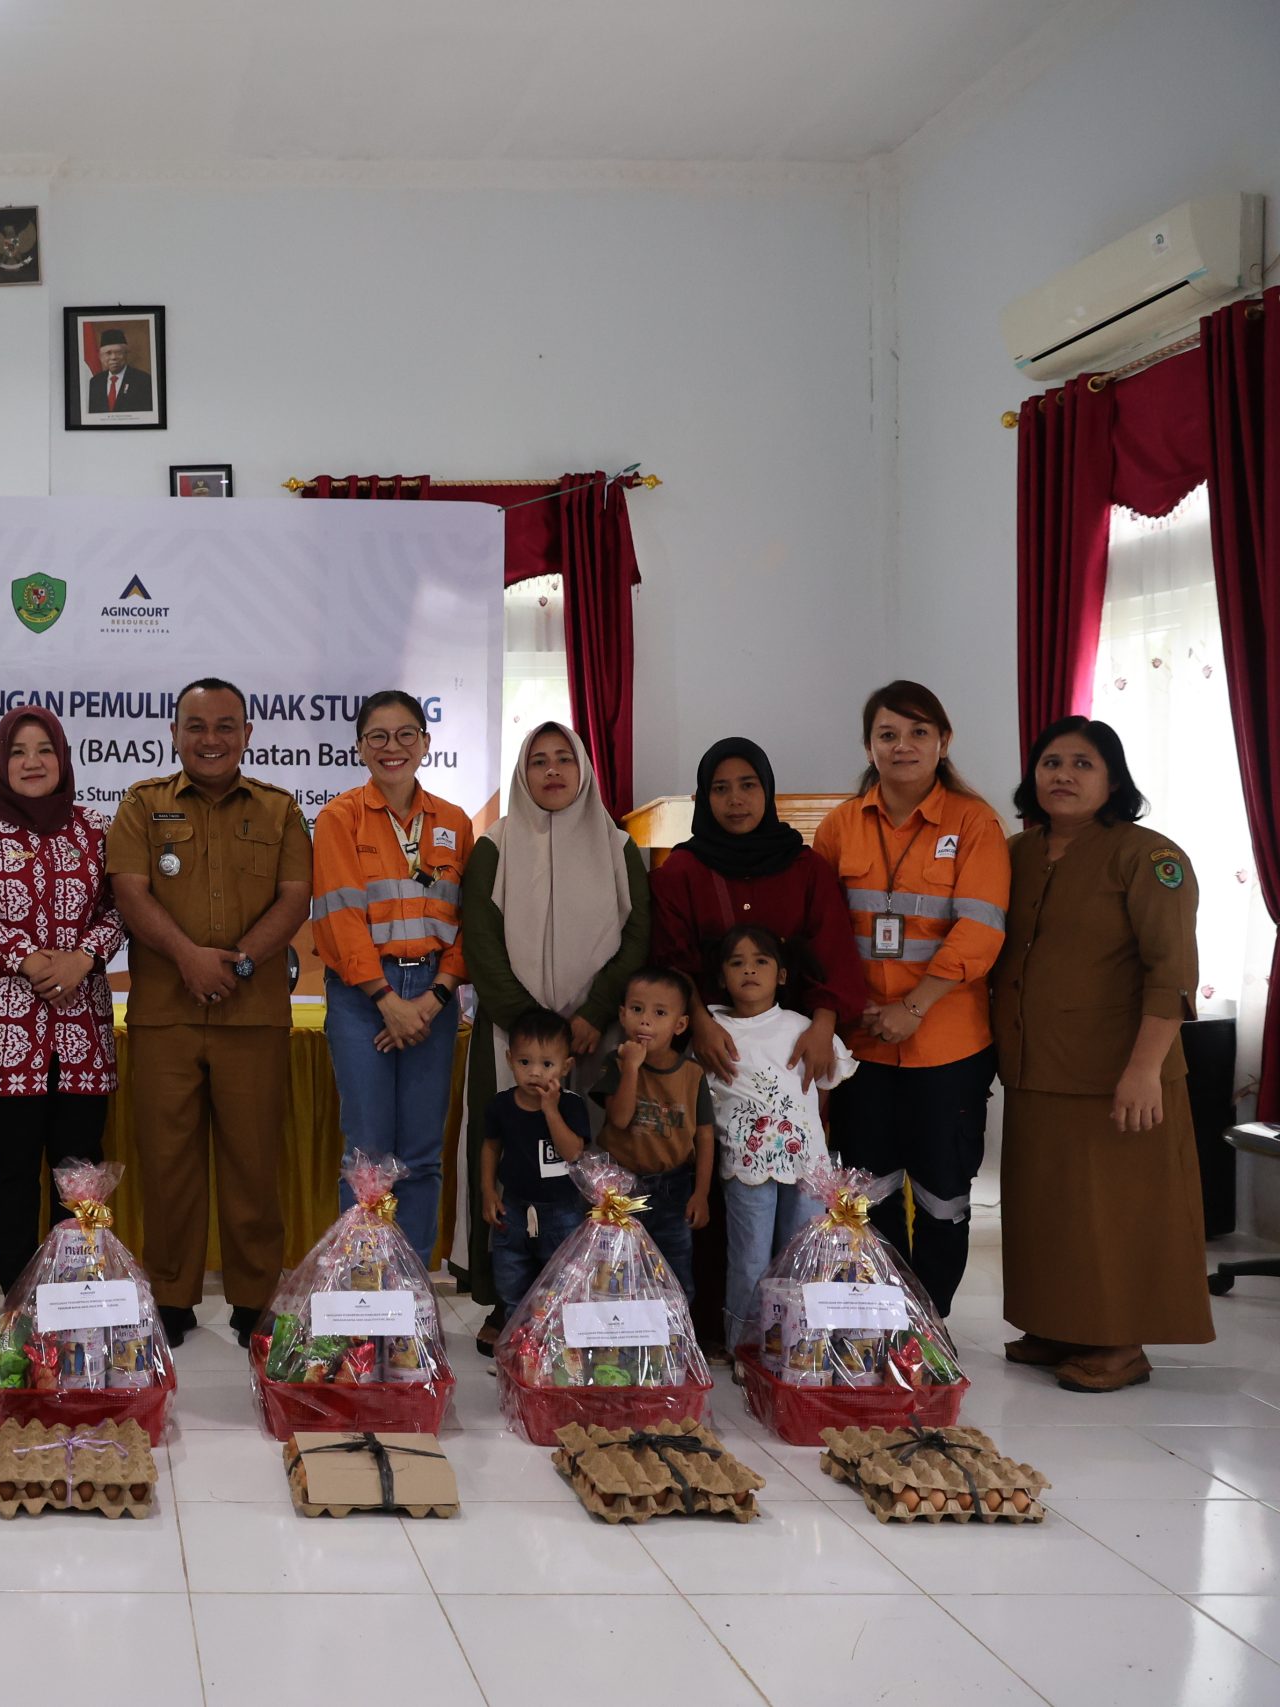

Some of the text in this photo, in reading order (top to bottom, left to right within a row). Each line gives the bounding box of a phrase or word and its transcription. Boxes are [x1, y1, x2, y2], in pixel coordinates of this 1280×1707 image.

[101, 606, 170, 617] AGINCOURT
[246, 693, 306, 721] NAK
[79, 738, 164, 767] (BAAS)
[421, 750, 457, 768] oru
